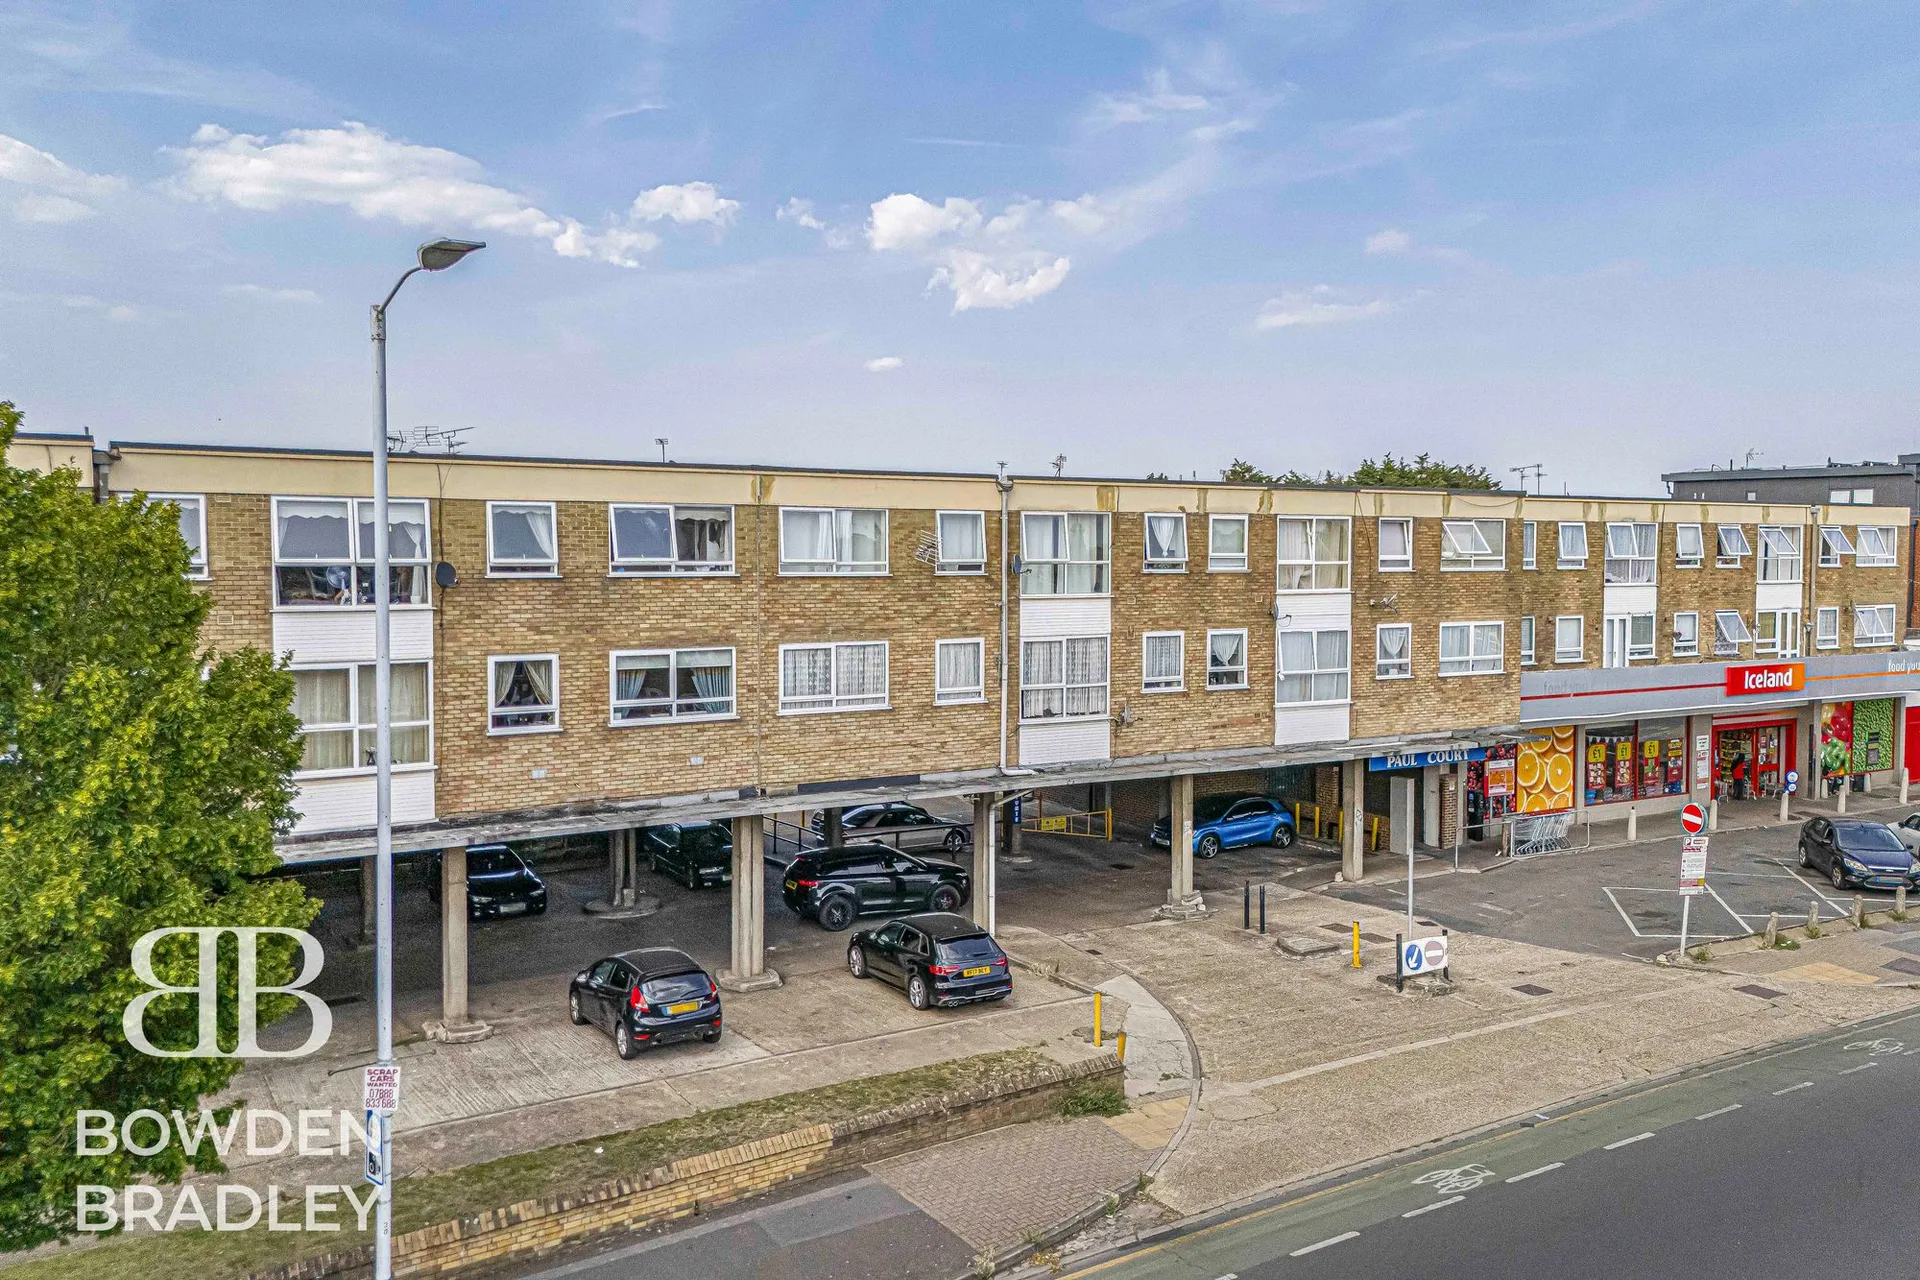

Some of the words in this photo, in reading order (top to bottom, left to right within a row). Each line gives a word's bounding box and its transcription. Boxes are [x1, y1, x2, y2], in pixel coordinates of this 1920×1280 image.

[1888, 660, 1906, 672] food
[1744, 668, 1793, 690] Iceland
[1592, 749, 1601, 759] £1
[1620, 746, 1628, 756] £1
[1648, 745, 1656, 755] £1
[1387, 753, 1417, 768] PAUL
[1427, 750, 1469, 764] COURT
